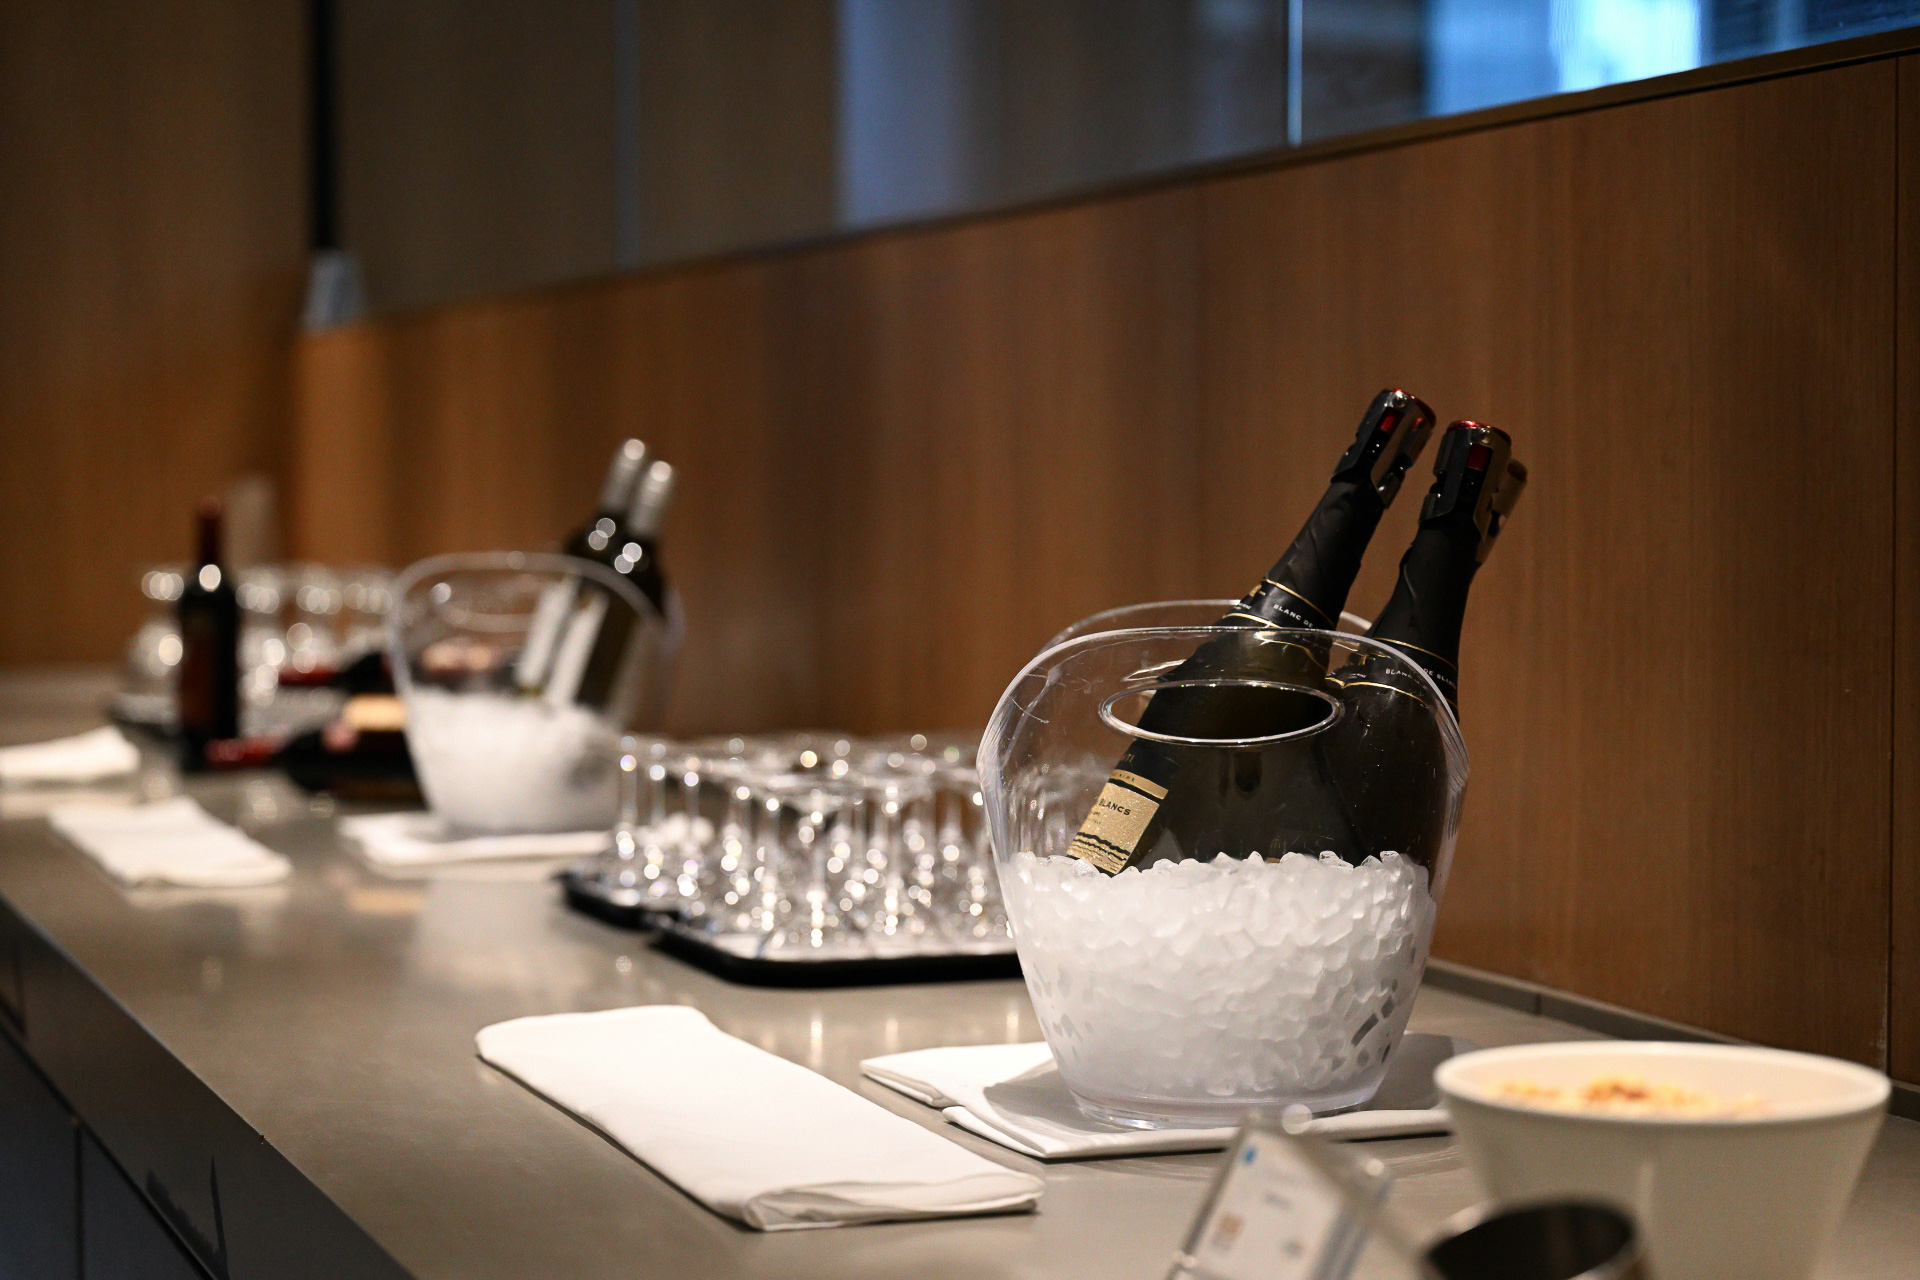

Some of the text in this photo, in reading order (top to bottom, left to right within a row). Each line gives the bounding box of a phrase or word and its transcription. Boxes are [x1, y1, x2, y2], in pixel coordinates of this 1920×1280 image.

[1273, 603, 1314, 628] BLANC DE
[1098, 798, 1132, 816] BLANCS
